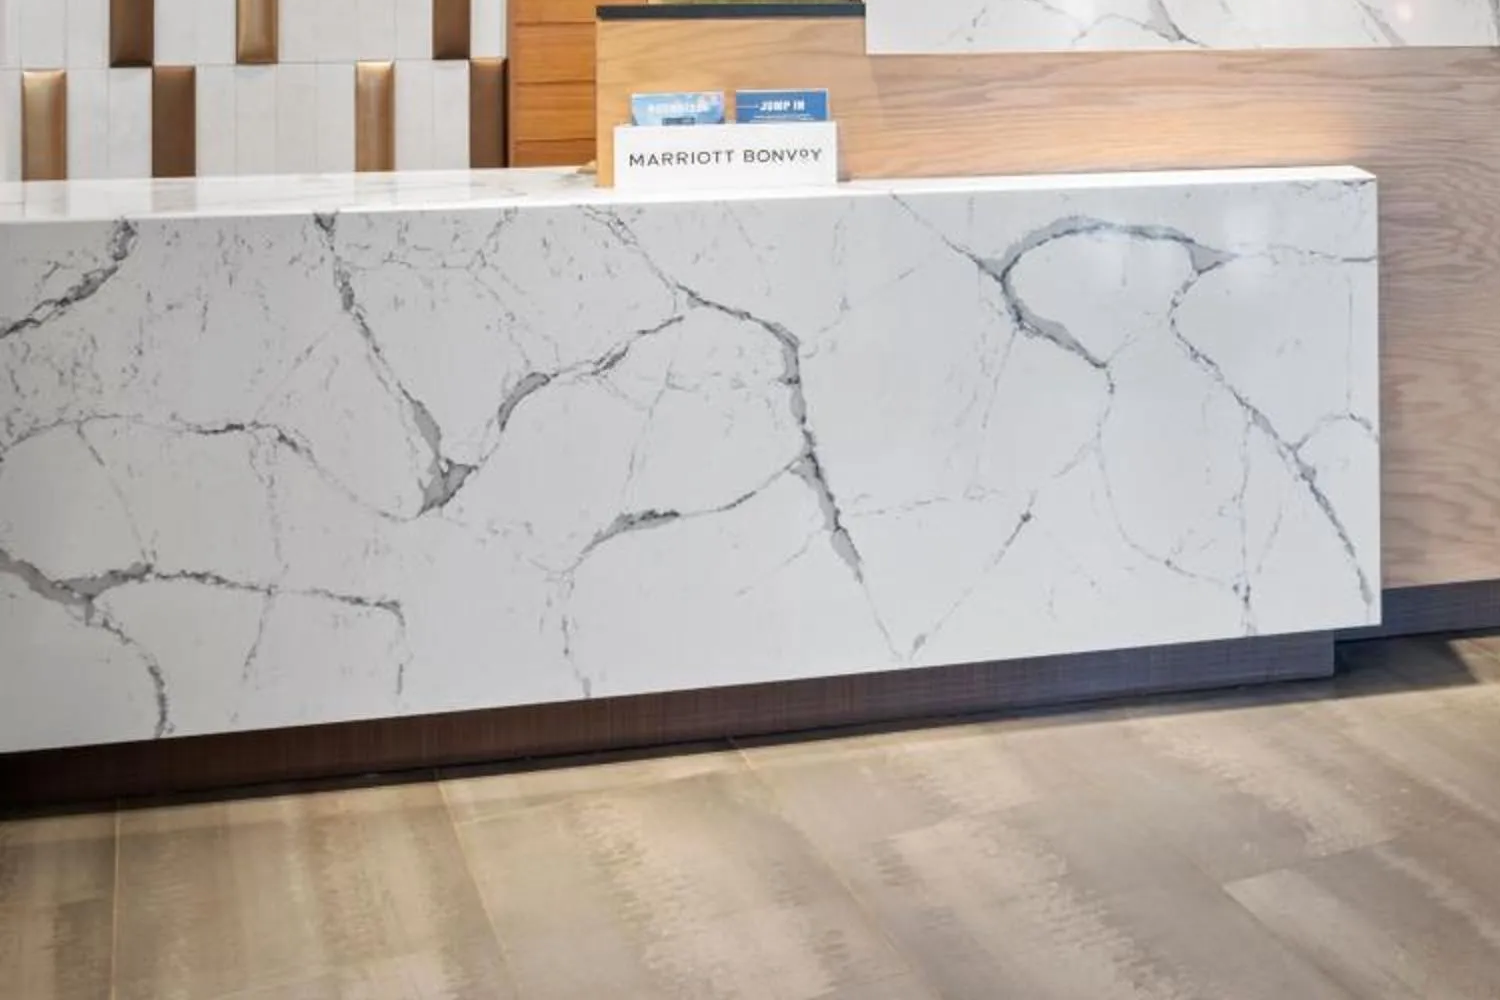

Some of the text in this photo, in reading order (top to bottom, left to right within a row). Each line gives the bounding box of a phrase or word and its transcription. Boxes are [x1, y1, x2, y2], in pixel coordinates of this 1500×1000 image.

[760, 99, 805, 112] JUMP IN
[629, 147, 823, 167] MARRIOTT BONVOY
